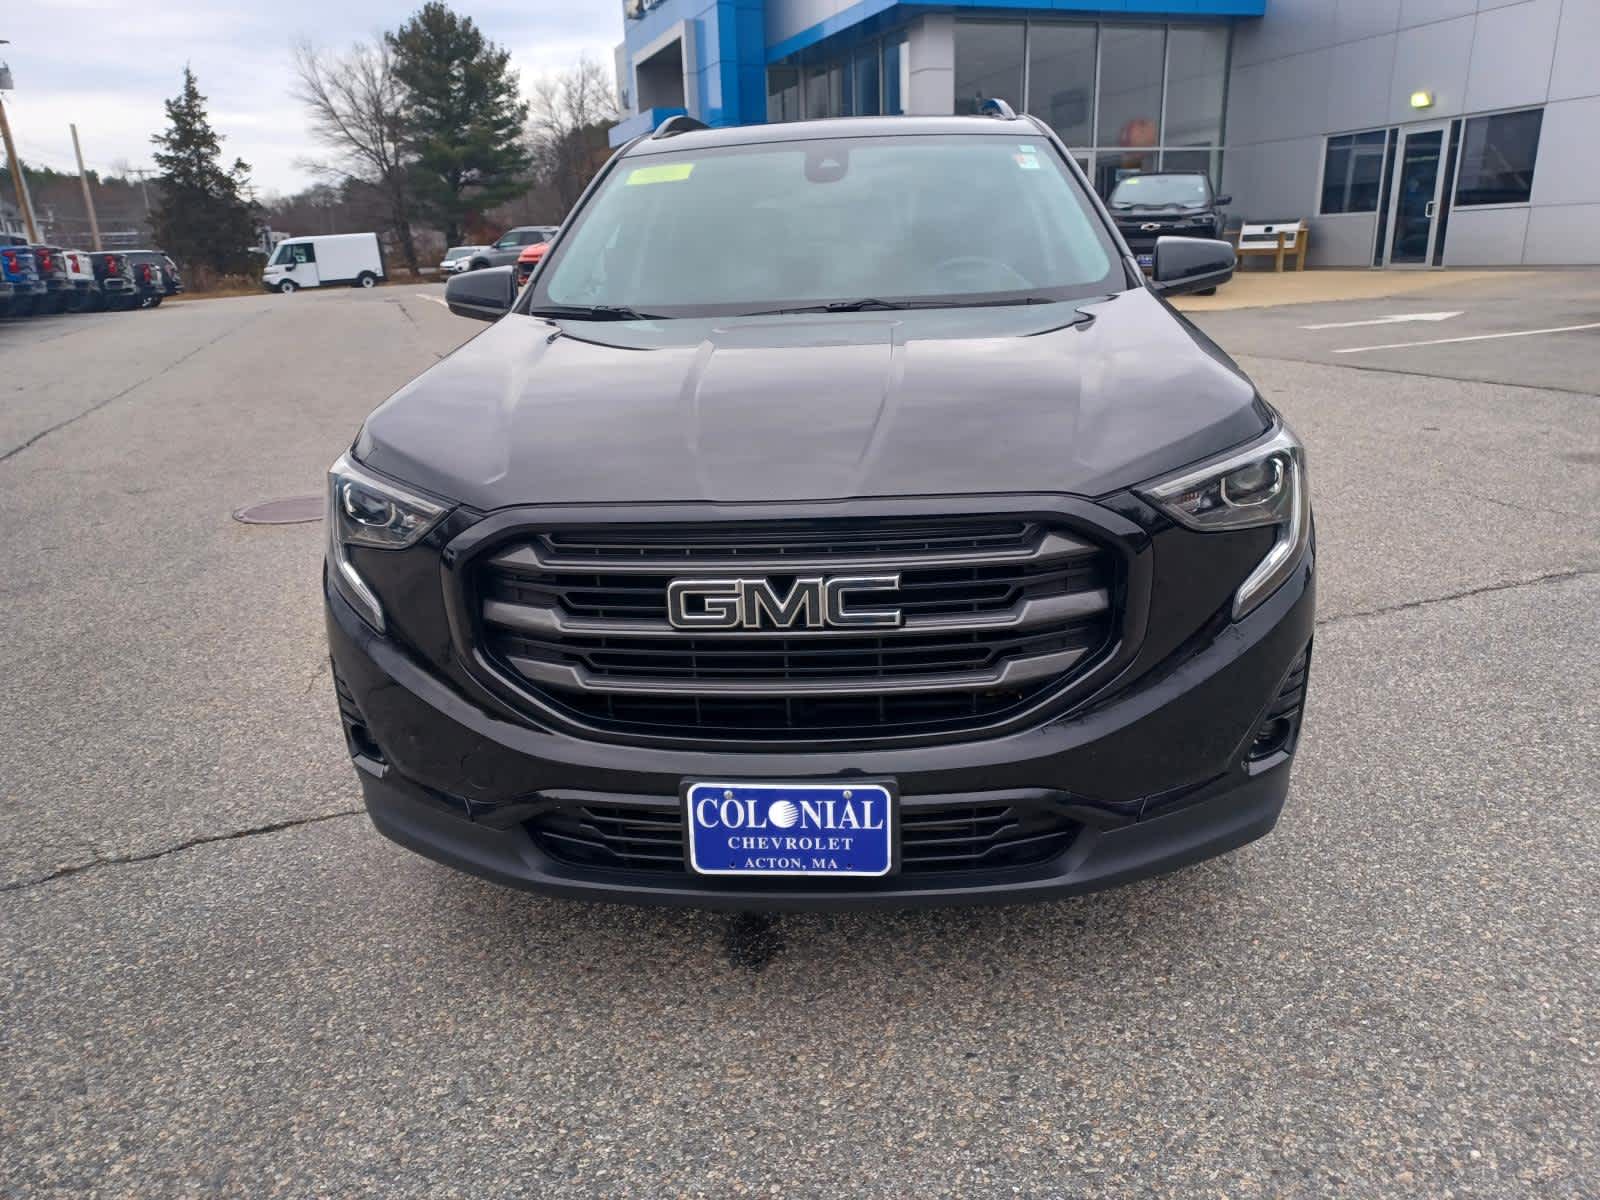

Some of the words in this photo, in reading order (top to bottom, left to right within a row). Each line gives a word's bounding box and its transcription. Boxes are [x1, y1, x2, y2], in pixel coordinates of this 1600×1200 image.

[667, 575, 901, 629] GMC
[728, 836, 854, 851] CHEVROLET
[744, 857, 806, 870] ACTON,
[812, 858, 838, 869] MA
